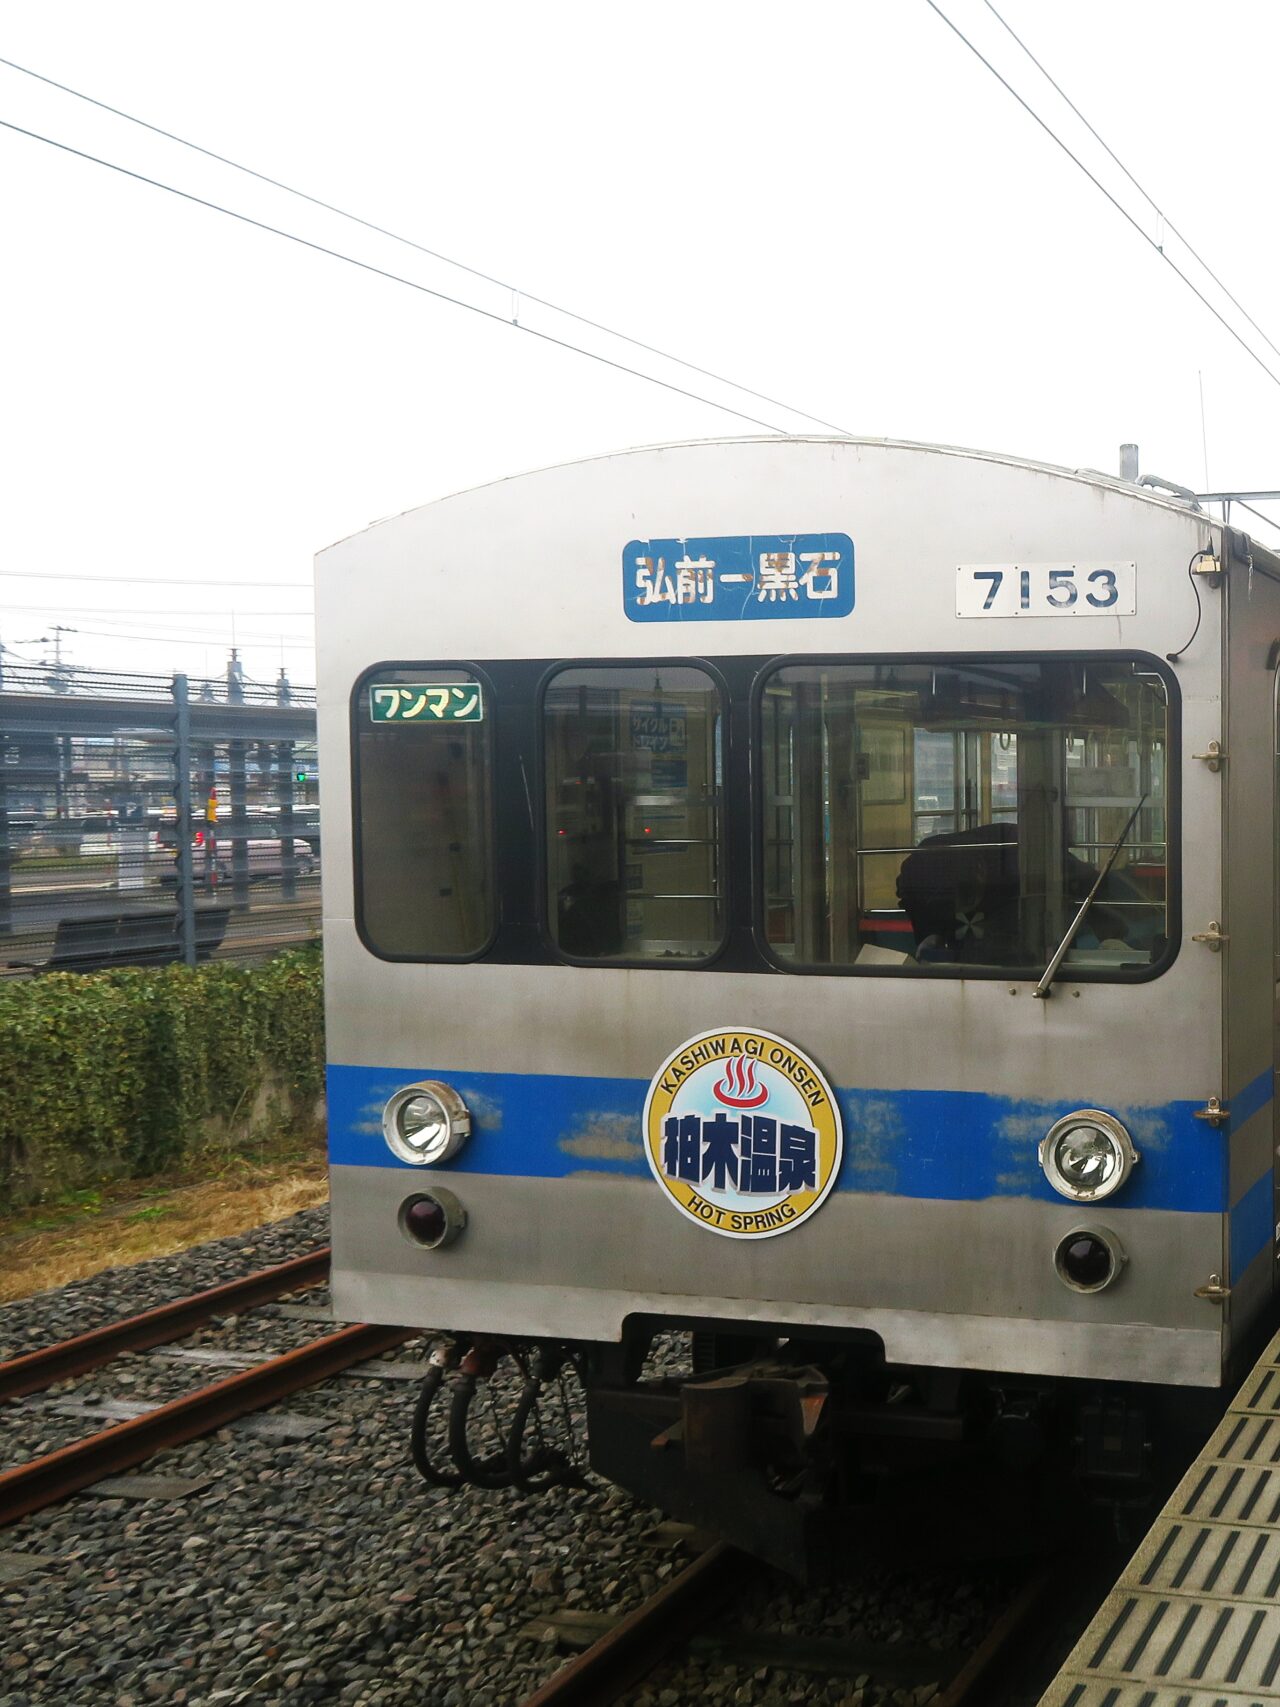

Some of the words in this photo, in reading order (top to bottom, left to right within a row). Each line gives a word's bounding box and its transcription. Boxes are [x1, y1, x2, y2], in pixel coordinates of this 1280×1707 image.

[973, 569, 1119, 610] 7153
[374, 687, 478, 718] ワンマン
[660, 1038, 764, 1094] KASHIWAGI
[769, 1048, 825, 1107] ONSEN
[663, 1112, 817, 1193] 柏木温泉
[687, 1195, 727, 1225] HOT
[730, 1203, 796, 1231] SPRING
